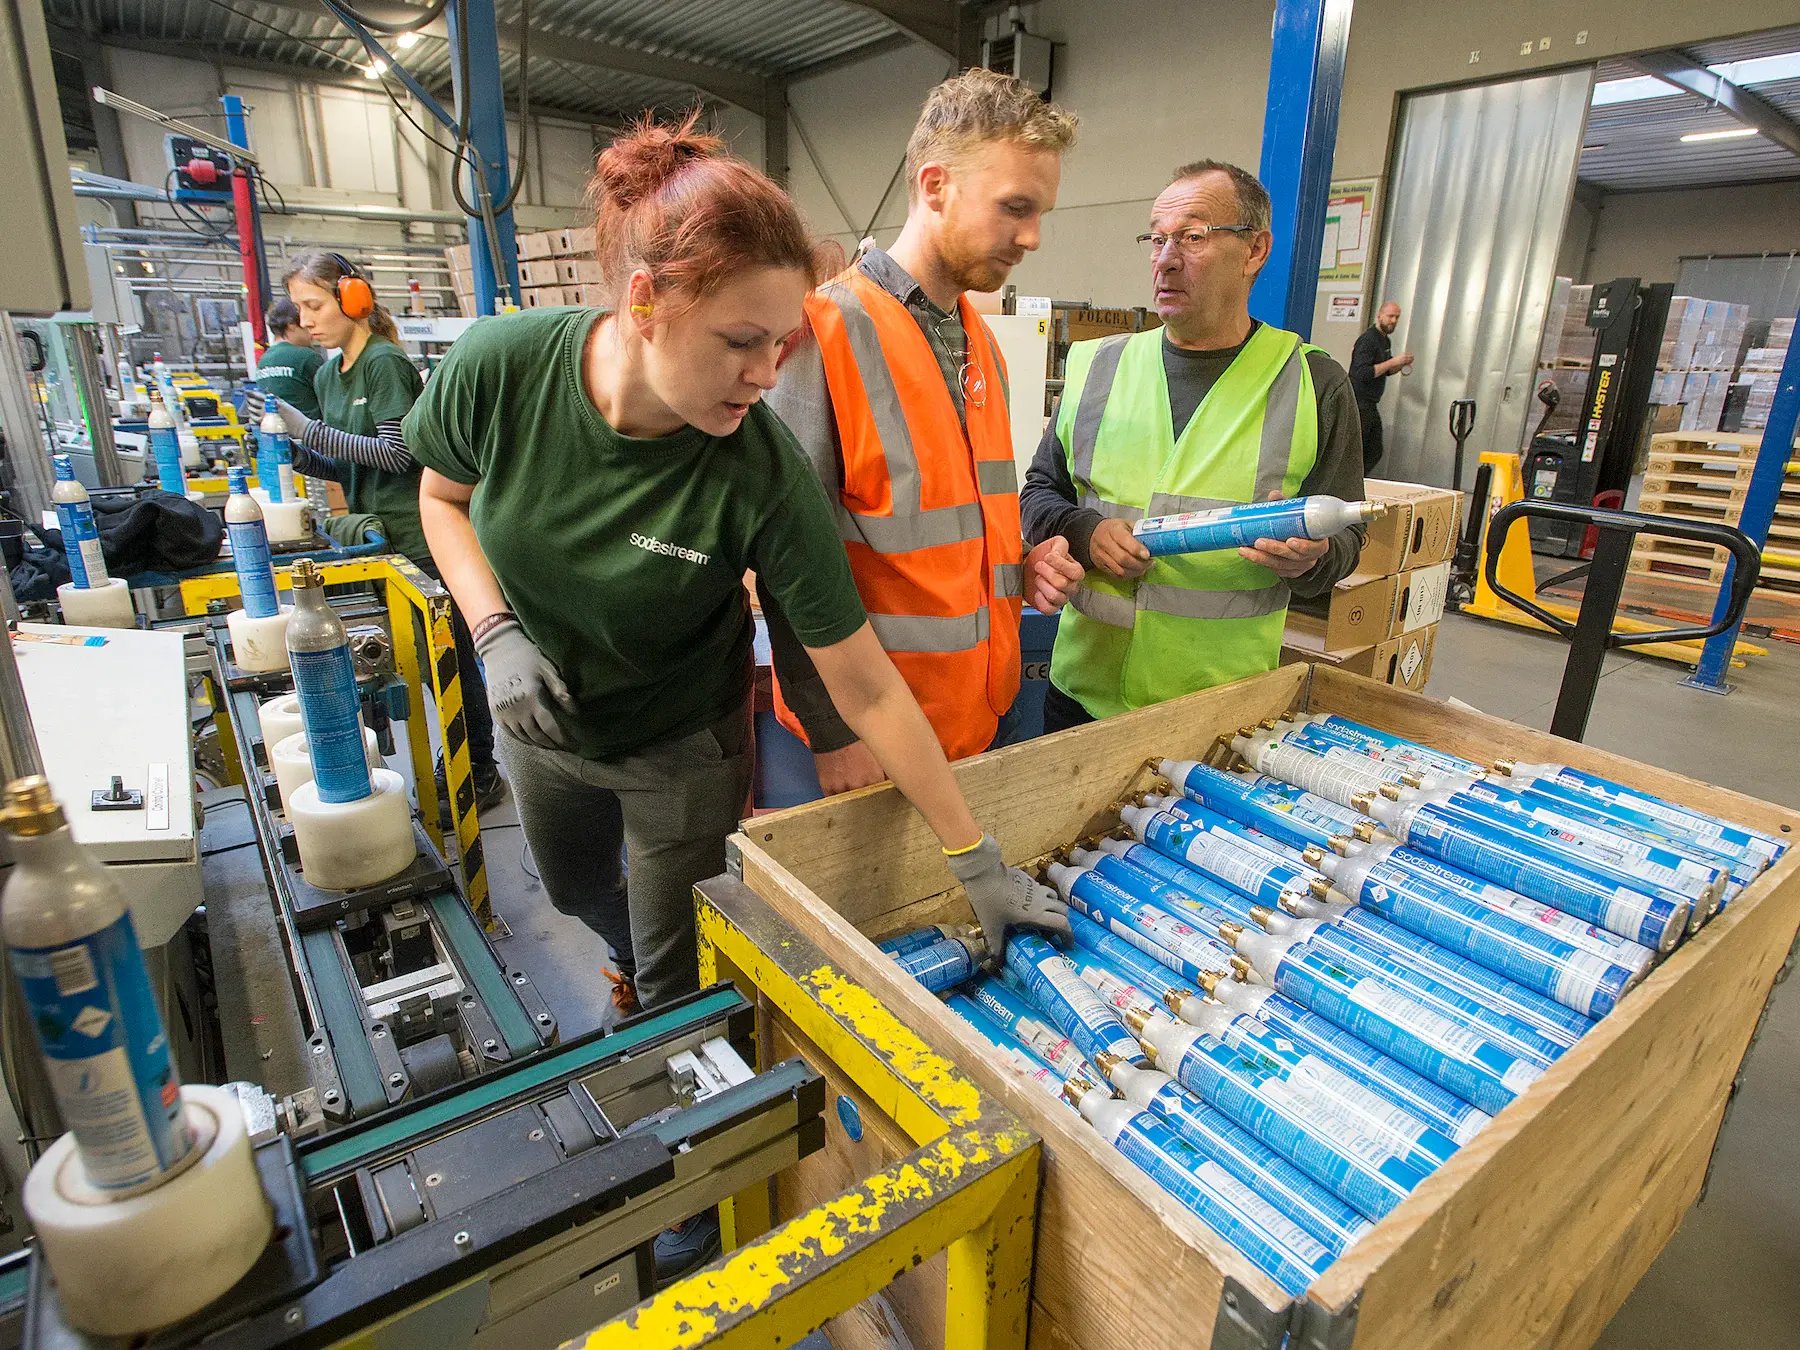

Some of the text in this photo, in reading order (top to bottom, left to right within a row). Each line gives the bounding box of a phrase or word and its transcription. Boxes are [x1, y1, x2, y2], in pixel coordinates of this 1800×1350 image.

[1039, 321, 1045, 333] 5
[1592, 370, 1612, 418] HYSTER
[629, 532, 711, 565] sodastream
[1350, 611, 1362, 622] 3
[1025, 664, 1048, 680] CE
[1327, 721, 1384, 746] sodastream
[1395, 849, 1475, 890] sodastream
